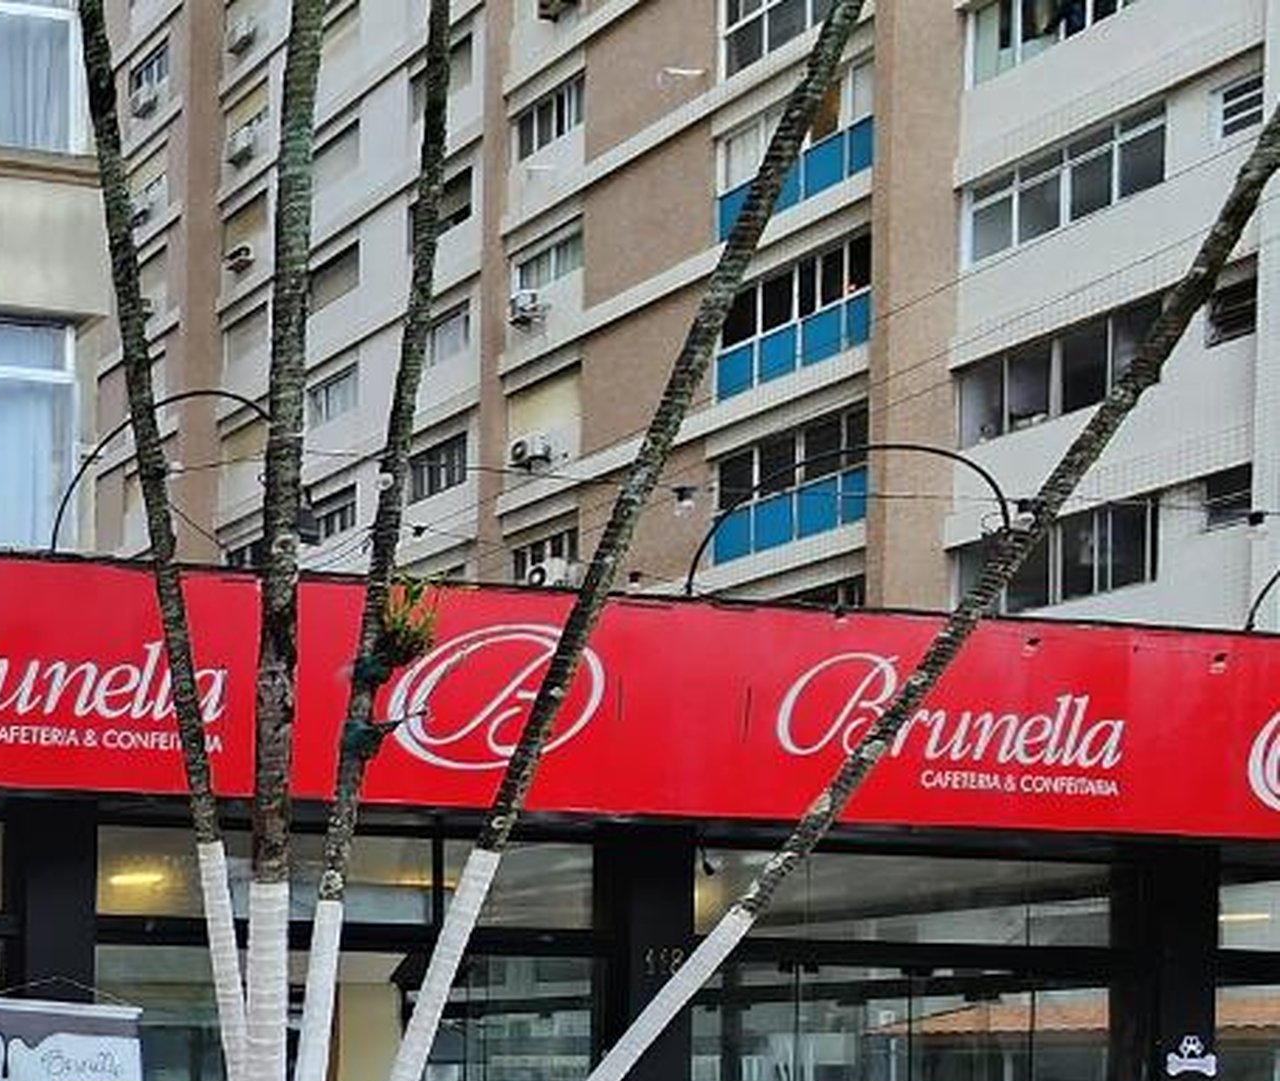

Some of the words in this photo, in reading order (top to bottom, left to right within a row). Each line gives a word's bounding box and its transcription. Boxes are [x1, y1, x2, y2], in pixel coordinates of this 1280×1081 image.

[776, 652, 1125, 769] Brunella
[83, 728, 98, 748] &
[921, 770, 1002, 790] CAFETERIA
[1004, 774, 1017, 792] &
[1019, 775, 1119, 797] CONFEITARIA
